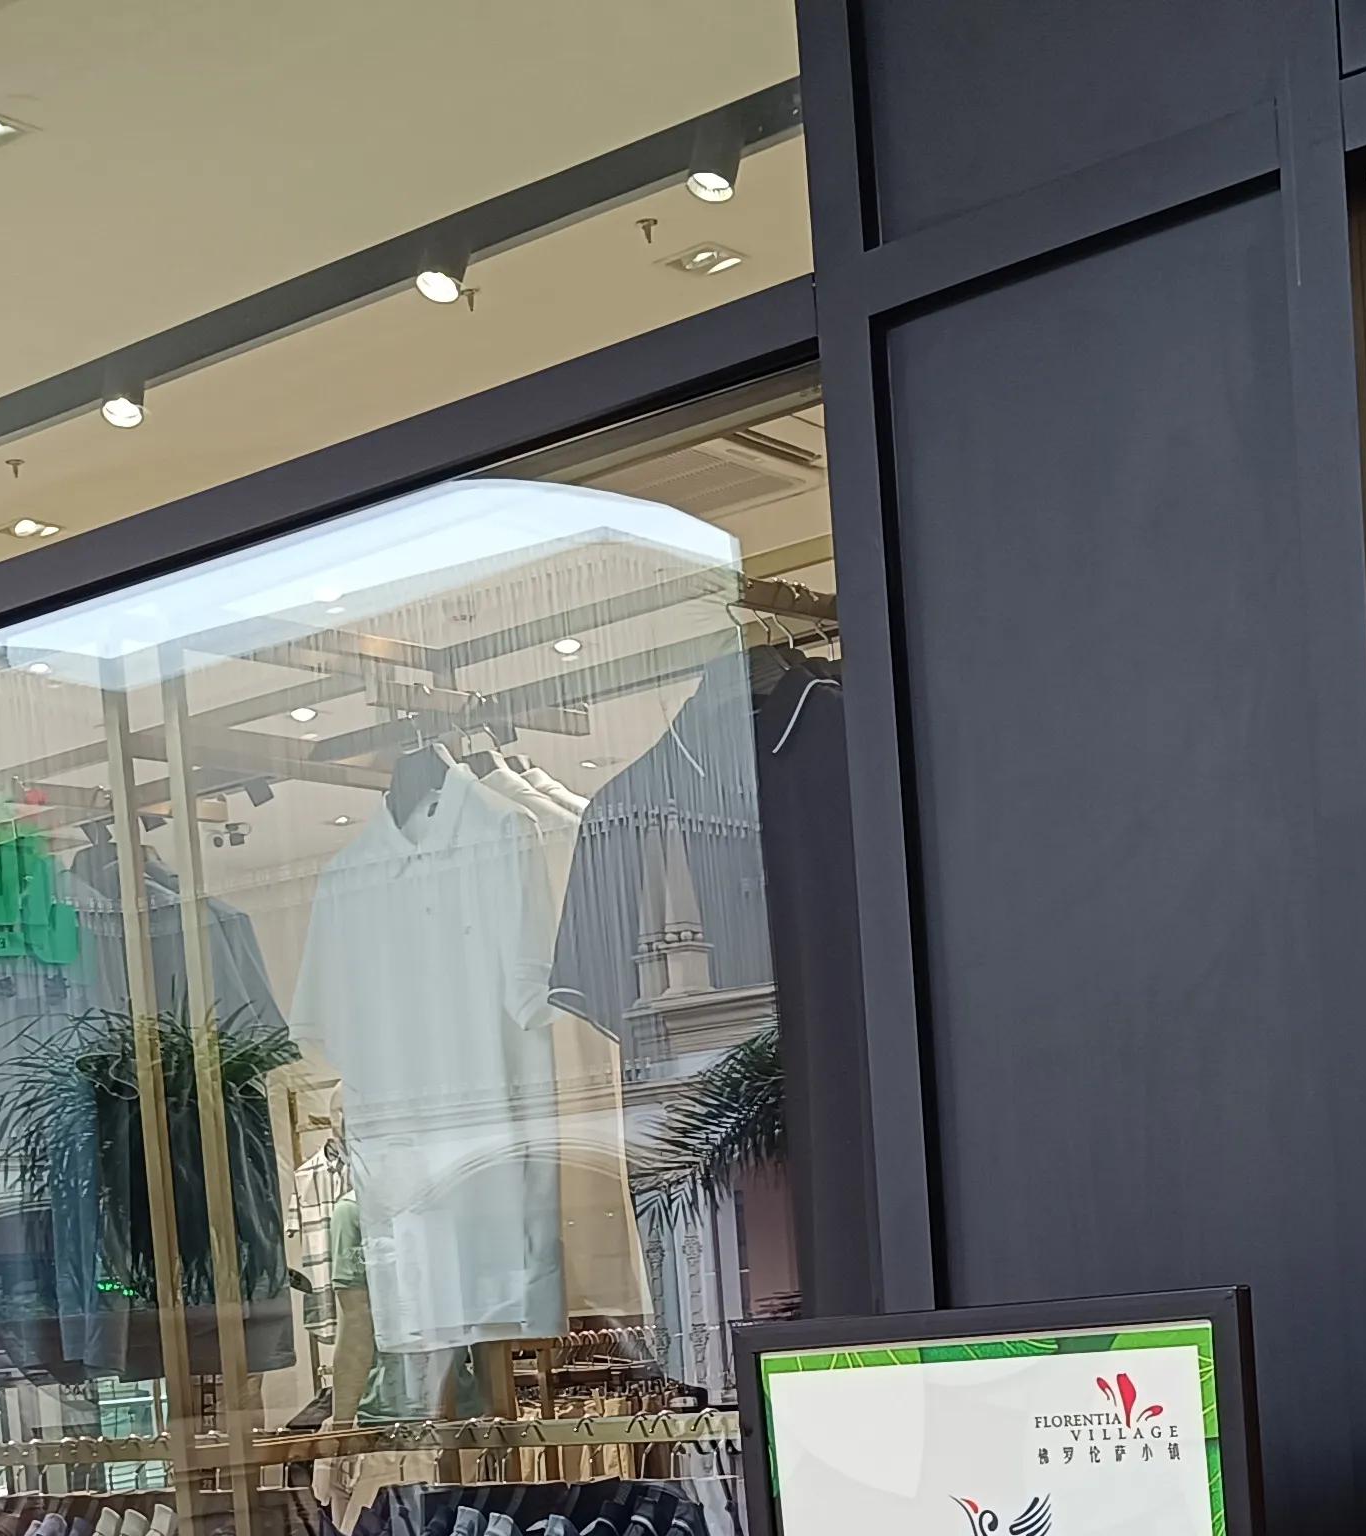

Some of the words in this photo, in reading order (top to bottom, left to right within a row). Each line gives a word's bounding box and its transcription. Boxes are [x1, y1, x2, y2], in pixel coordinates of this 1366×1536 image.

[1035, 1413, 1122, 1428] FLORENTIA
[1071, 1426, 1178, 1441] VILLAGE
[1038, 1443, 1181, 1465] 佛罗伦萨小镇
